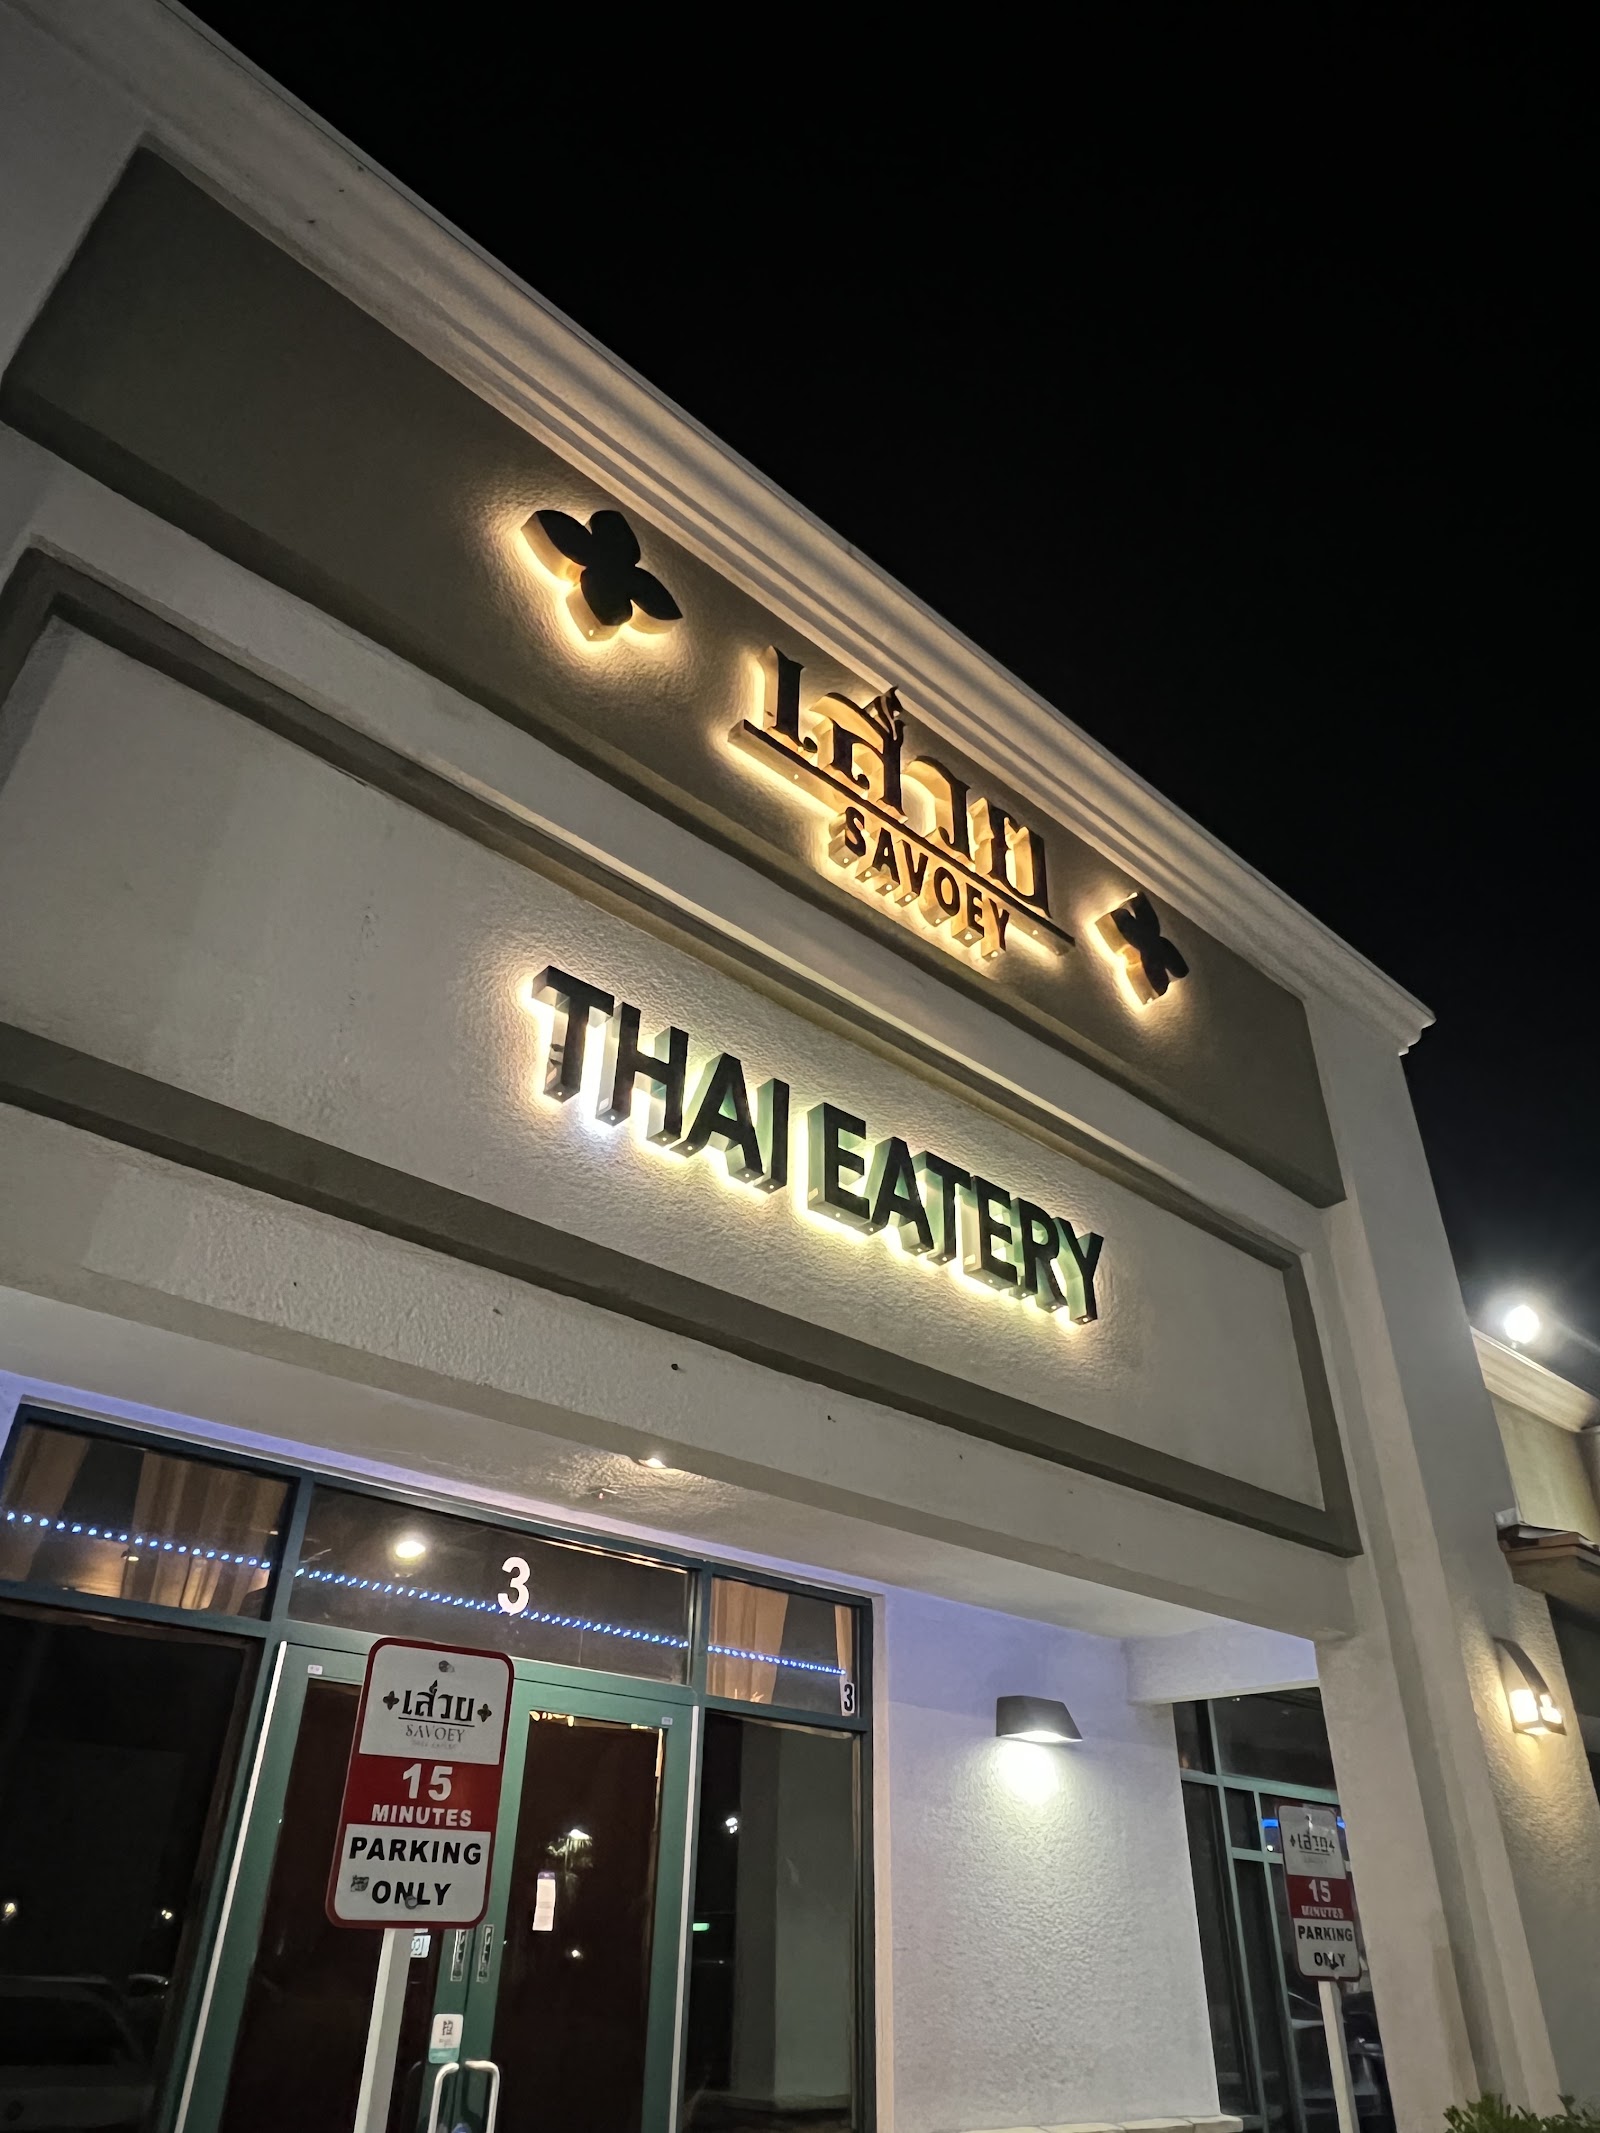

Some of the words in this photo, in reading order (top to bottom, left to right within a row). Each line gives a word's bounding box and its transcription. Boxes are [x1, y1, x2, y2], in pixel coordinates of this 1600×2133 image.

[836, 804, 1010, 955] SAVOEY
[533, 965, 790, 1190] THAI
[811, 1102, 1104, 1323] EATERY
[497, 1556, 531, 1615] 3
[844, 1683, 854, 1712] 3
[405, 1724, 465, 1743] SAVOEY
[402, 1763, 453, 1801] 15
[371, 1804, 472, 1827] MINUTES
[349, 1837, 482, 1865] PARKING
[371, 1880, 451, 1906] ONLY
[1308, 1879, 1331, 1903] 15
[1301, 1906, 1344, 1919] MINUTES
[1298, 1925, 1353, 1941] PARKING
